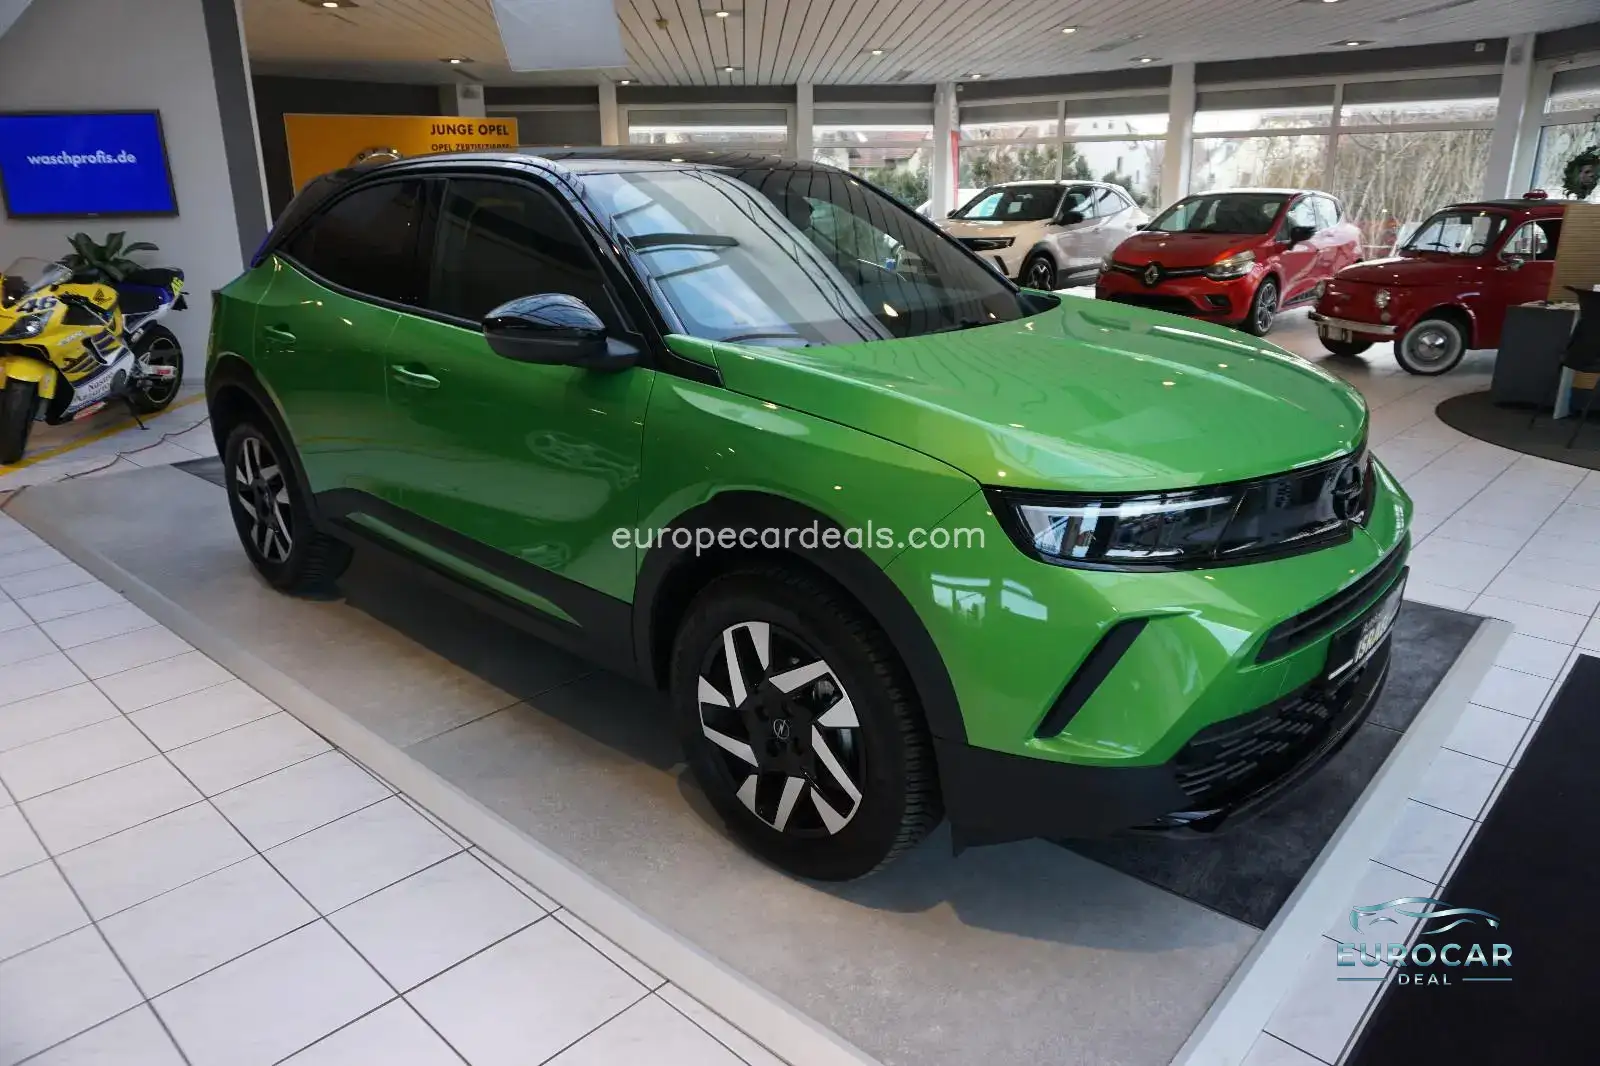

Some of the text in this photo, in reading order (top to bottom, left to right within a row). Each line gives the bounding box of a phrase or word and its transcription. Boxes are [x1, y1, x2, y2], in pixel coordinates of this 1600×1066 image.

[430, 123, 510, 136] JUNGE OPEL
[431, 143, 452, 153] OPEL
[27, 149, 137, 168] waschprofis.de
